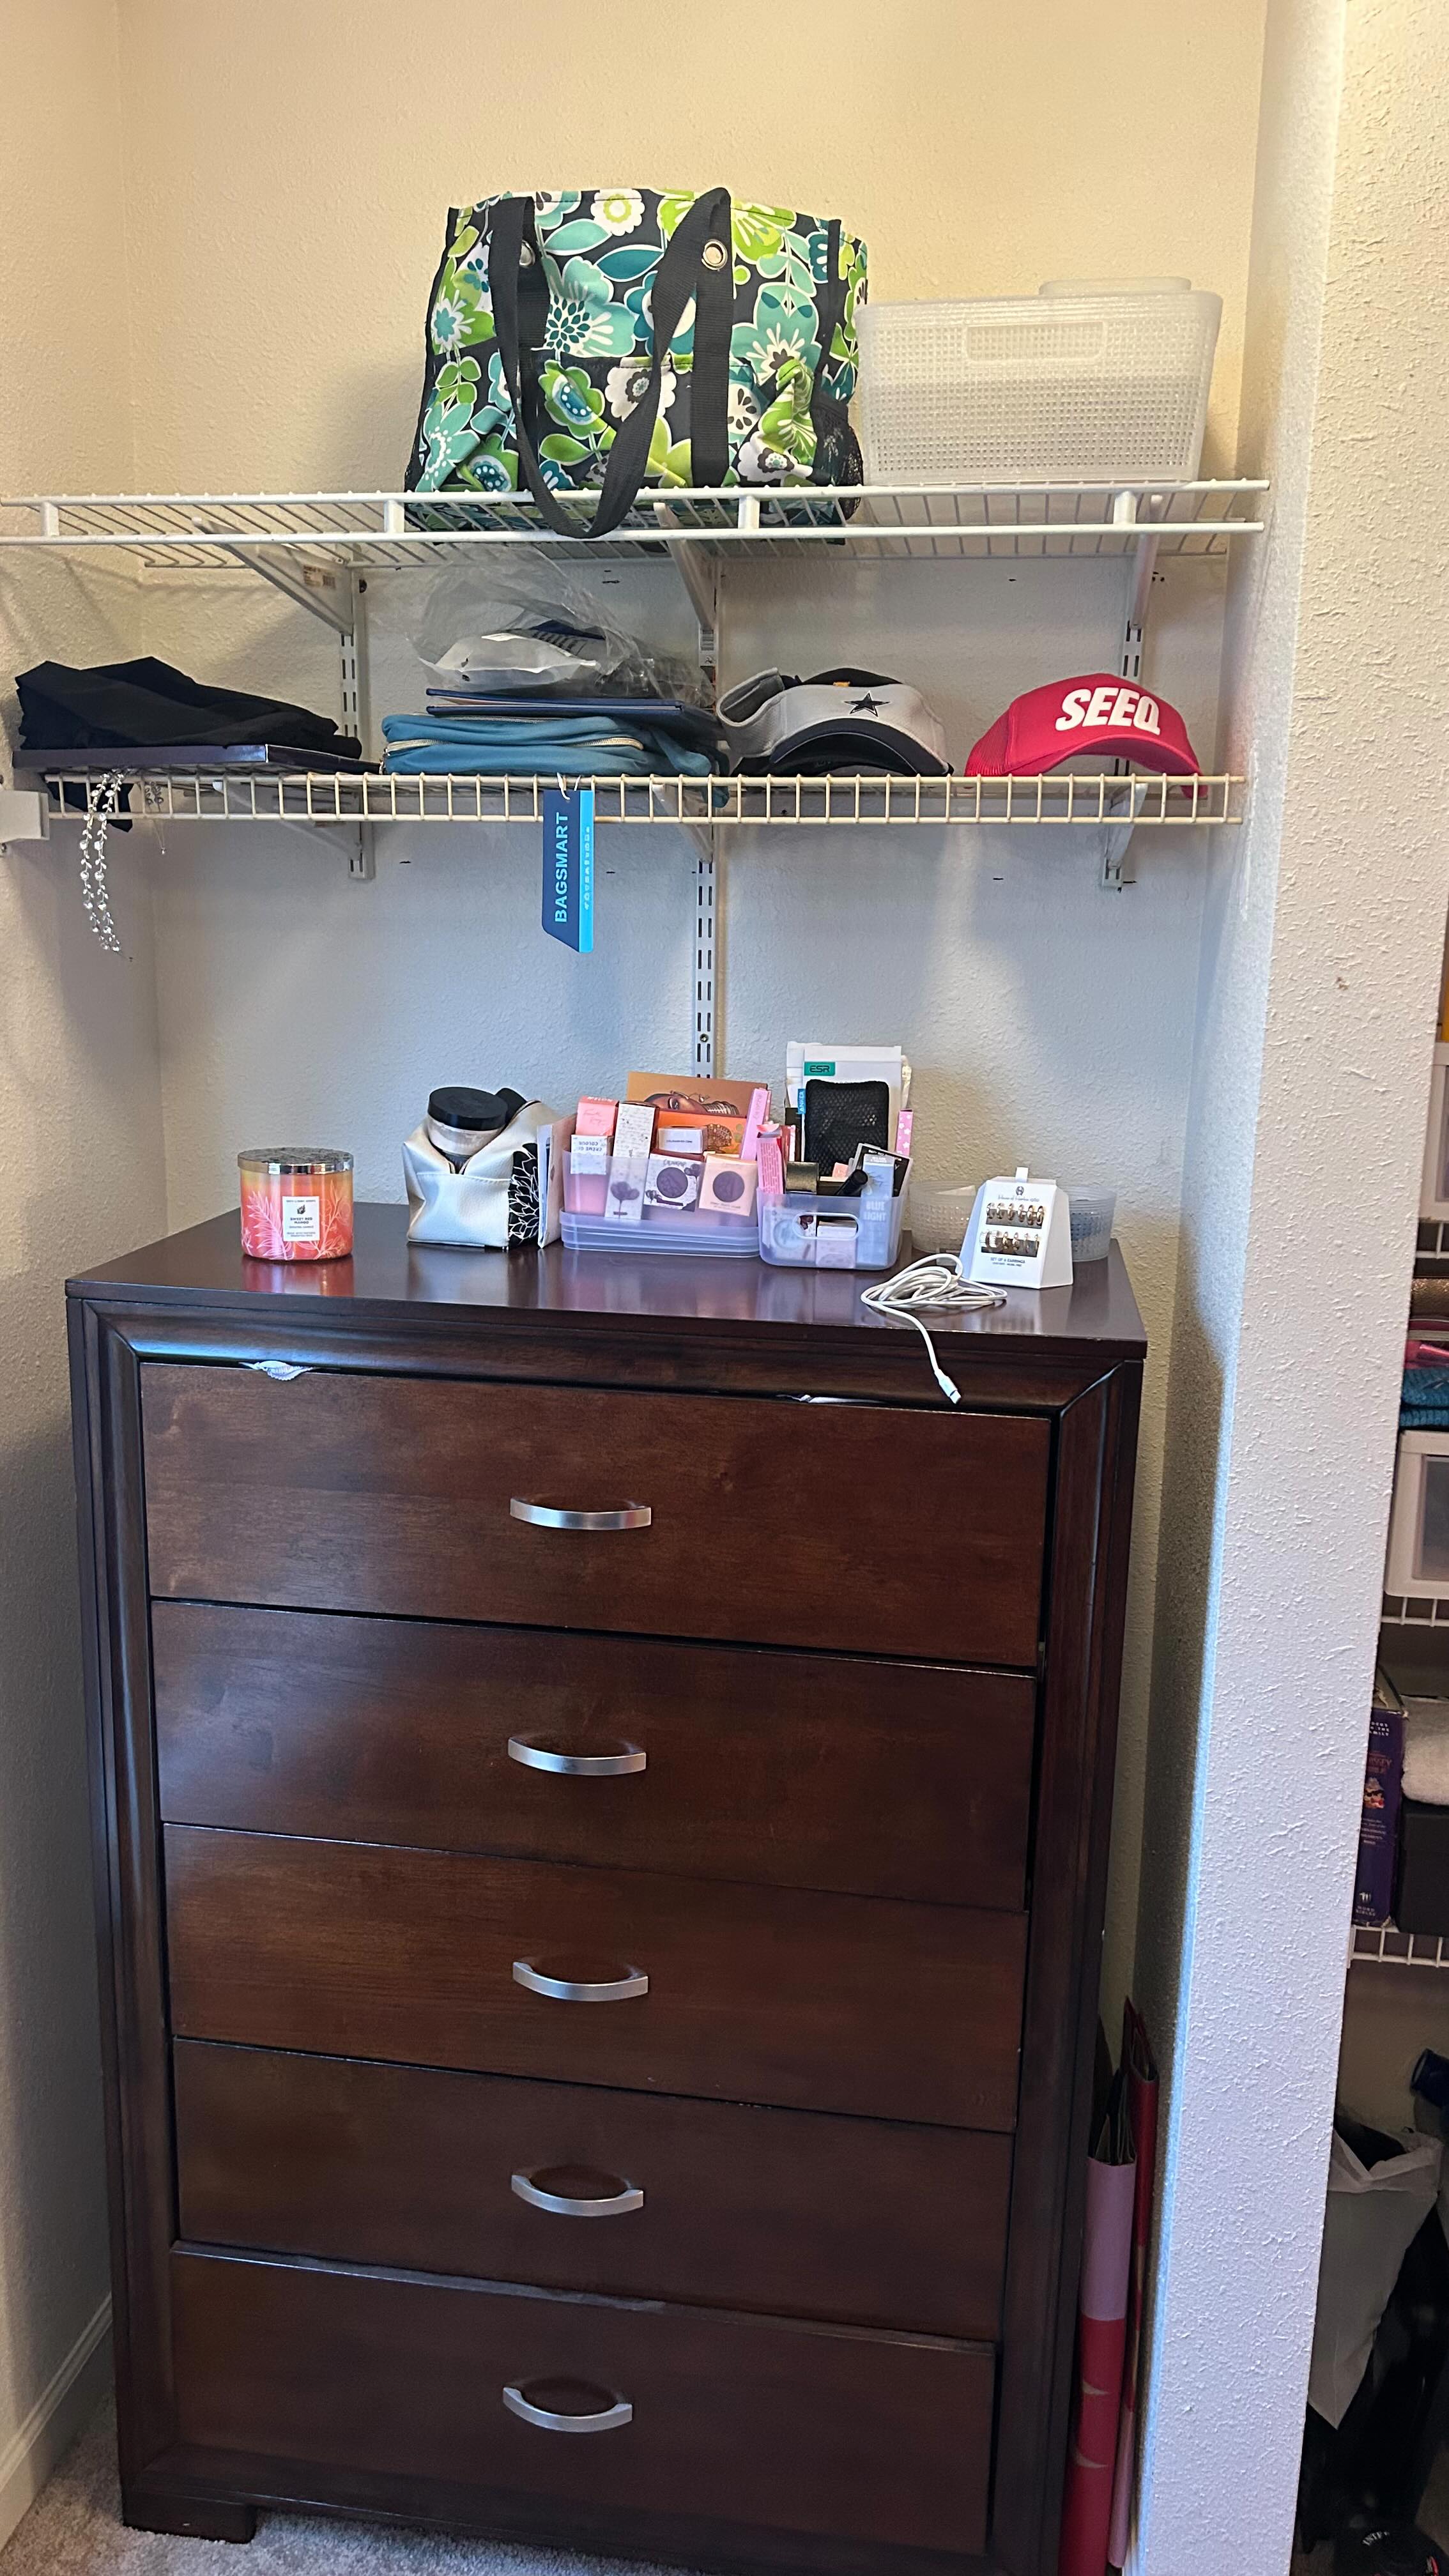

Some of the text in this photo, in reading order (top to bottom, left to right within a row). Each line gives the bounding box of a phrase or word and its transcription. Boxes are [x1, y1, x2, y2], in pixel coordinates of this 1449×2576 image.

[1055, 687, 1161, 735] SEEQ
[555, 812, 569, 923] BAGSMART
[809, 1065, 830, 1073] ESR
[866, 1201, 885, 1211] BLUE
[862, 1211, 887, 1221] LIGHT
